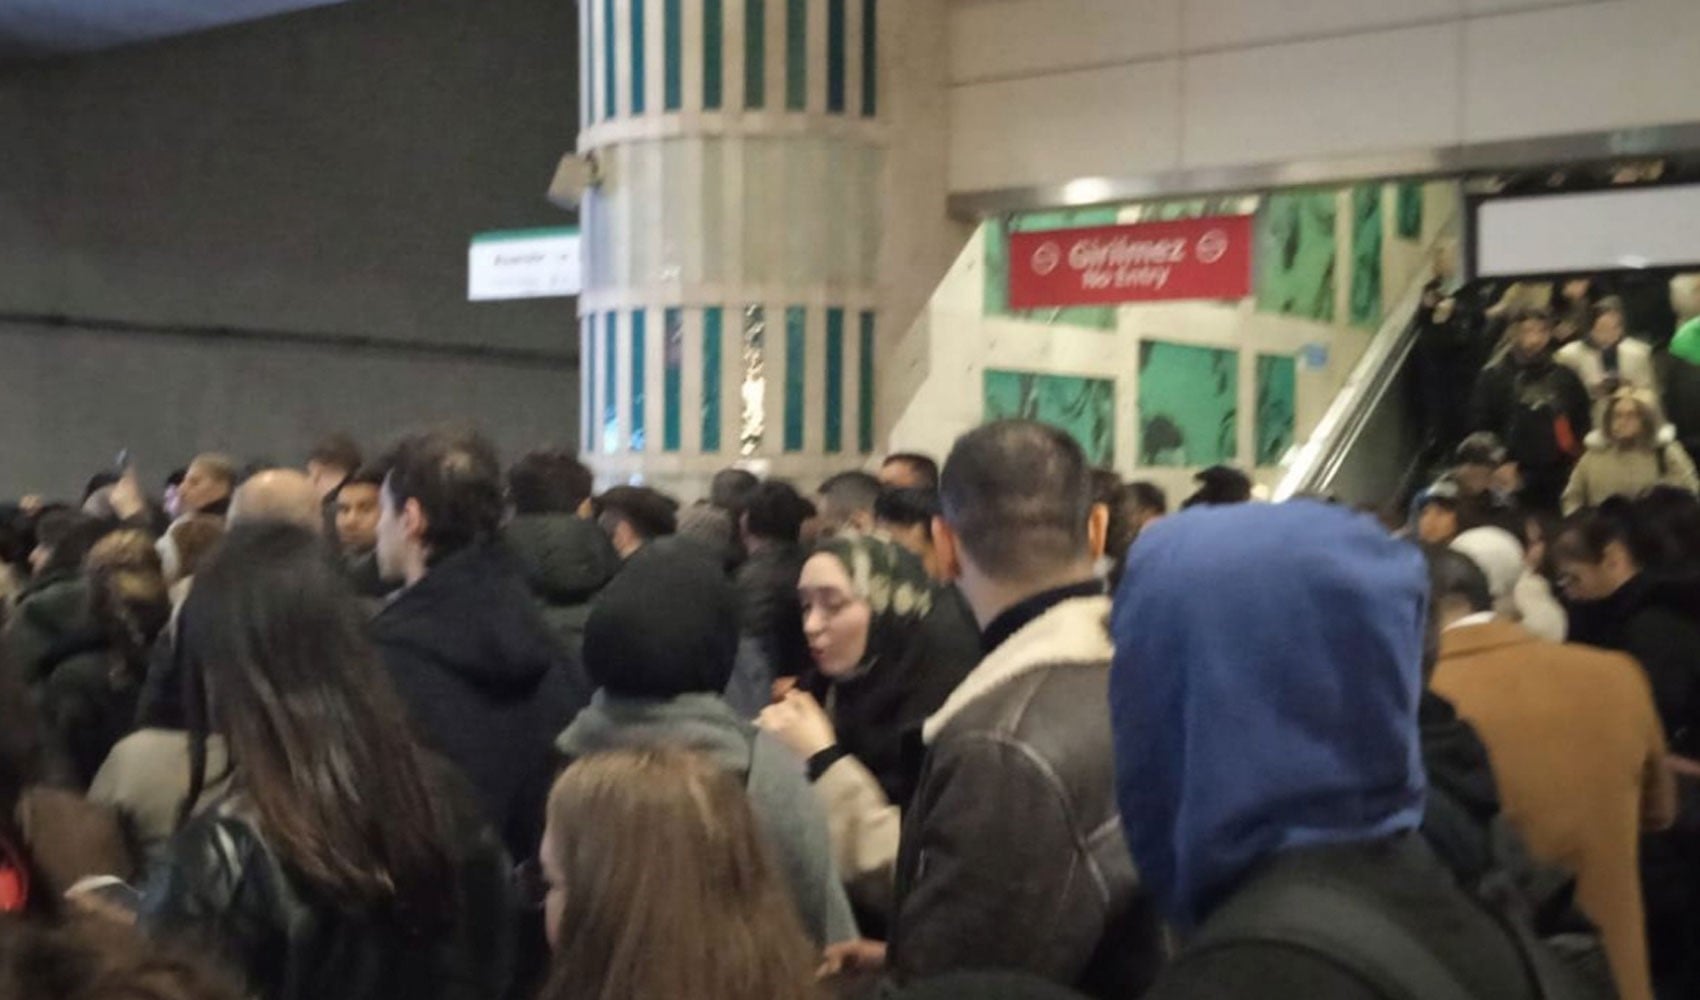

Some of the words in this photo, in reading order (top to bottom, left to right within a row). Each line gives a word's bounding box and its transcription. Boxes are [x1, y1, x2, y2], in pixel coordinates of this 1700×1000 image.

[1069, 237, 1187, 269] Girilmez
[1082, 268, 1112, 289] No
[1114, 266, 1170, 290] Entry
